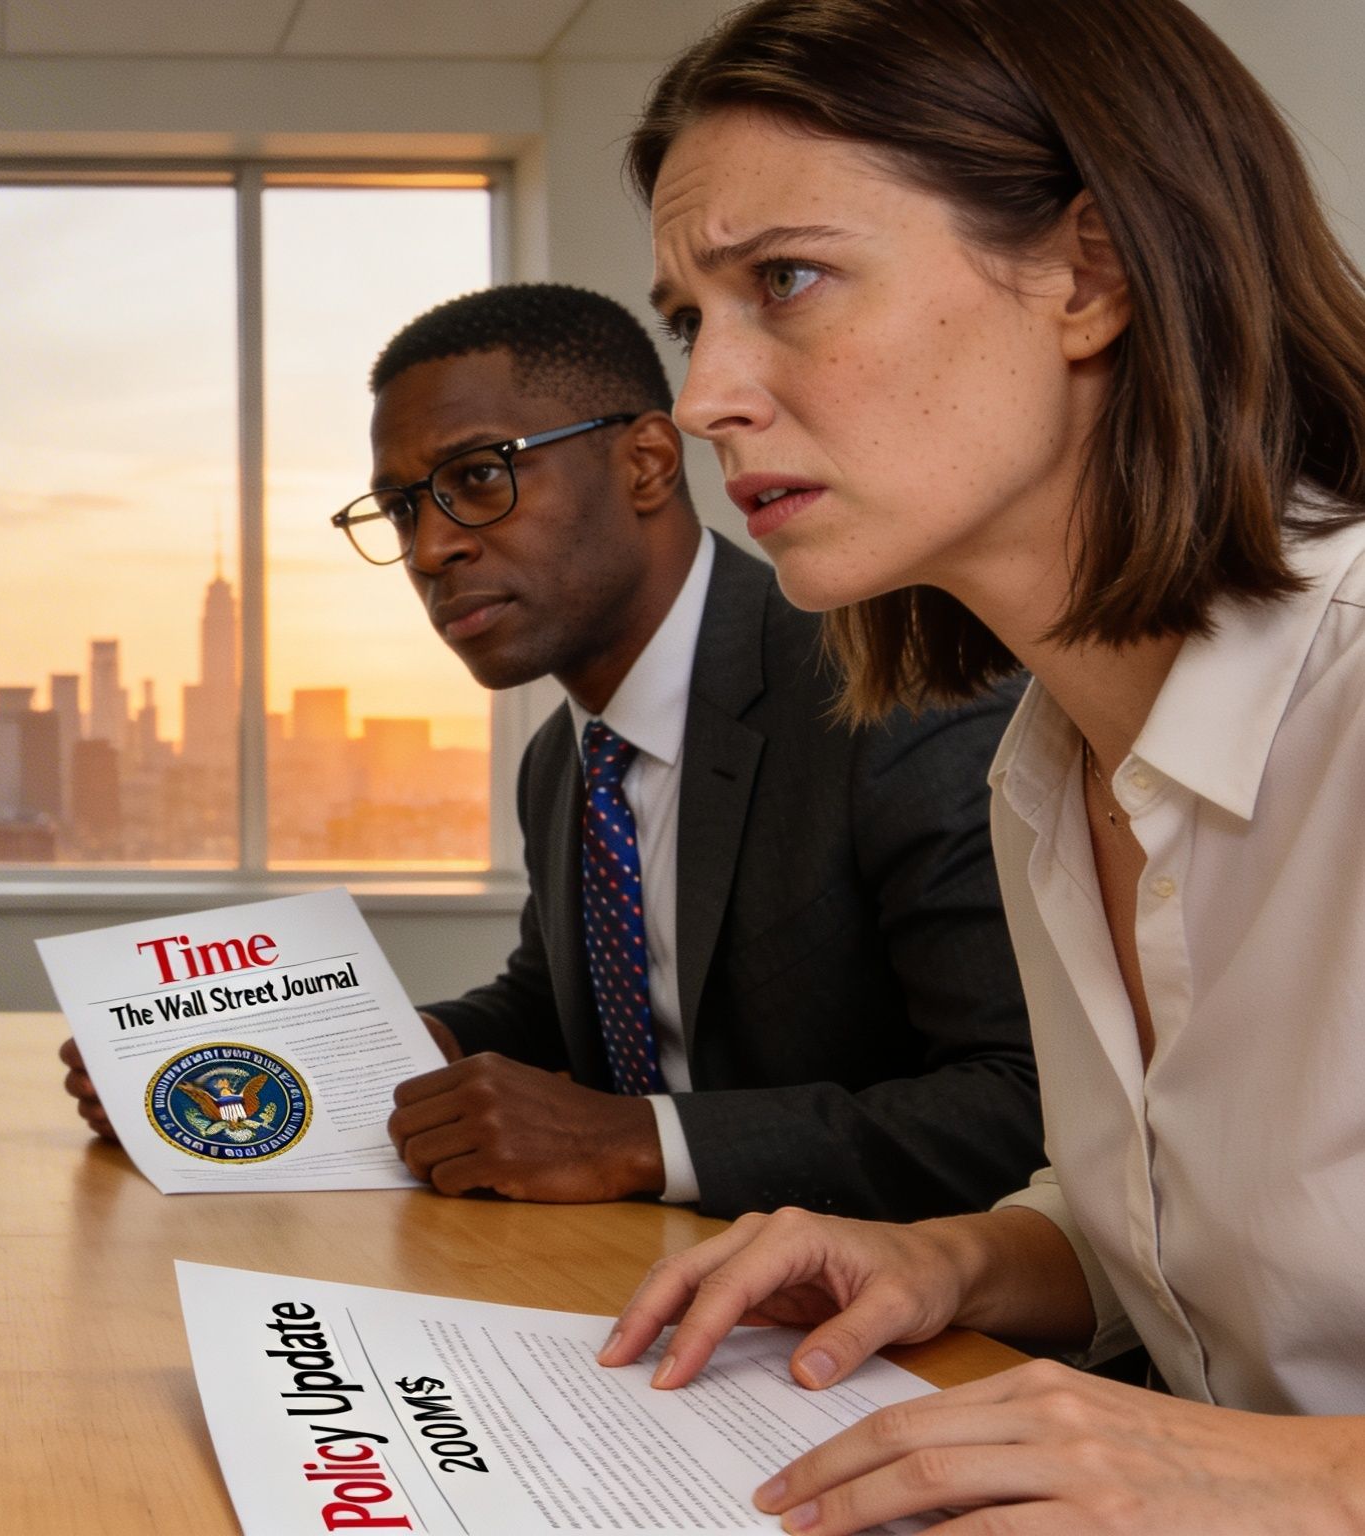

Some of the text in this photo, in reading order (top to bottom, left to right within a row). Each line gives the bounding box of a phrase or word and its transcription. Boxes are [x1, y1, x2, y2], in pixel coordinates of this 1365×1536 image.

[109, 1002, 155, 1031] The
[155, 989, 208, 1021] Wall
[210, 980, 279, 1013] Street
[281, 962, 360, 1001] Journal
[136, 933, 280, 985] Time
[265, 1301, 414, 1532] Policy Update
[395, 1376, 490, 1473] 200M$
